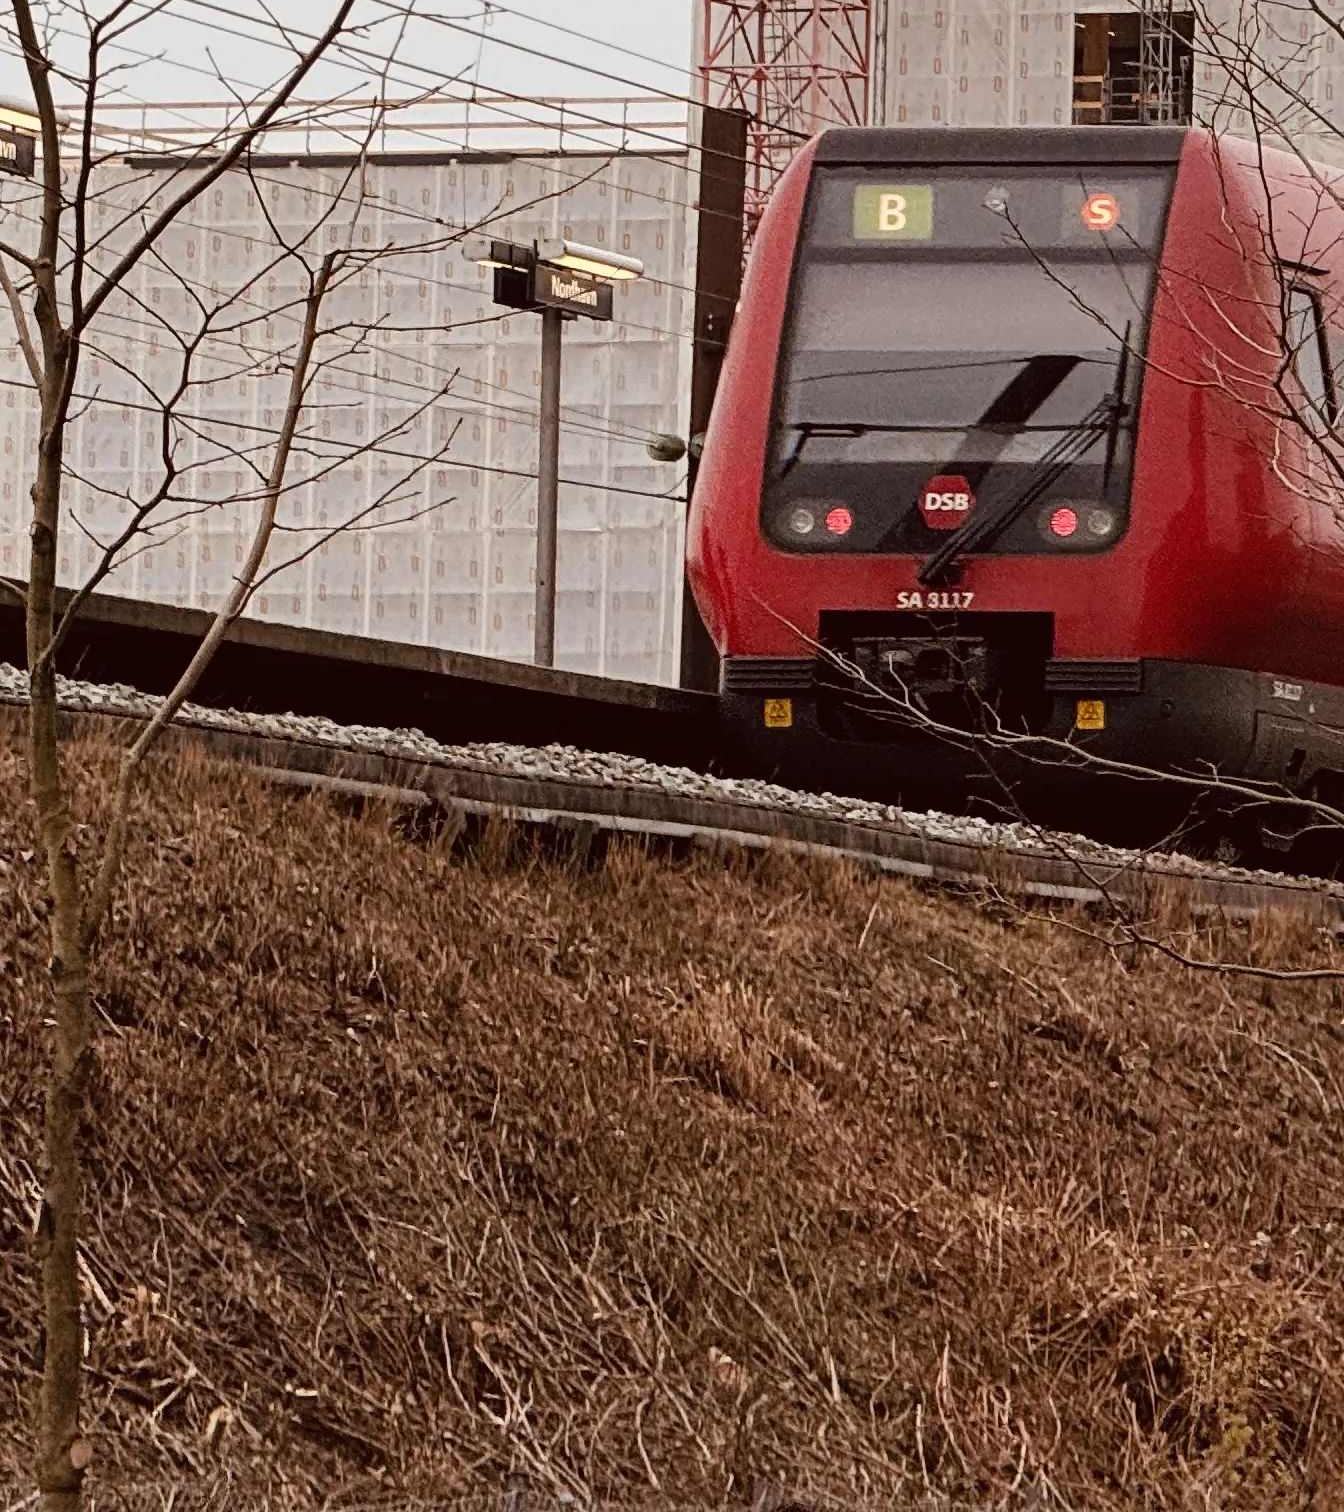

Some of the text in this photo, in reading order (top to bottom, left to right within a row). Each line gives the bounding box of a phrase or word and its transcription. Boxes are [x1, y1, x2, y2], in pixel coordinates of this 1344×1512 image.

[878, 194, 907, 231] B
[1089, 199, 1114, 225] S
[924, 492, 970, 511] DSB
[895, 591, 923, 609] SA
